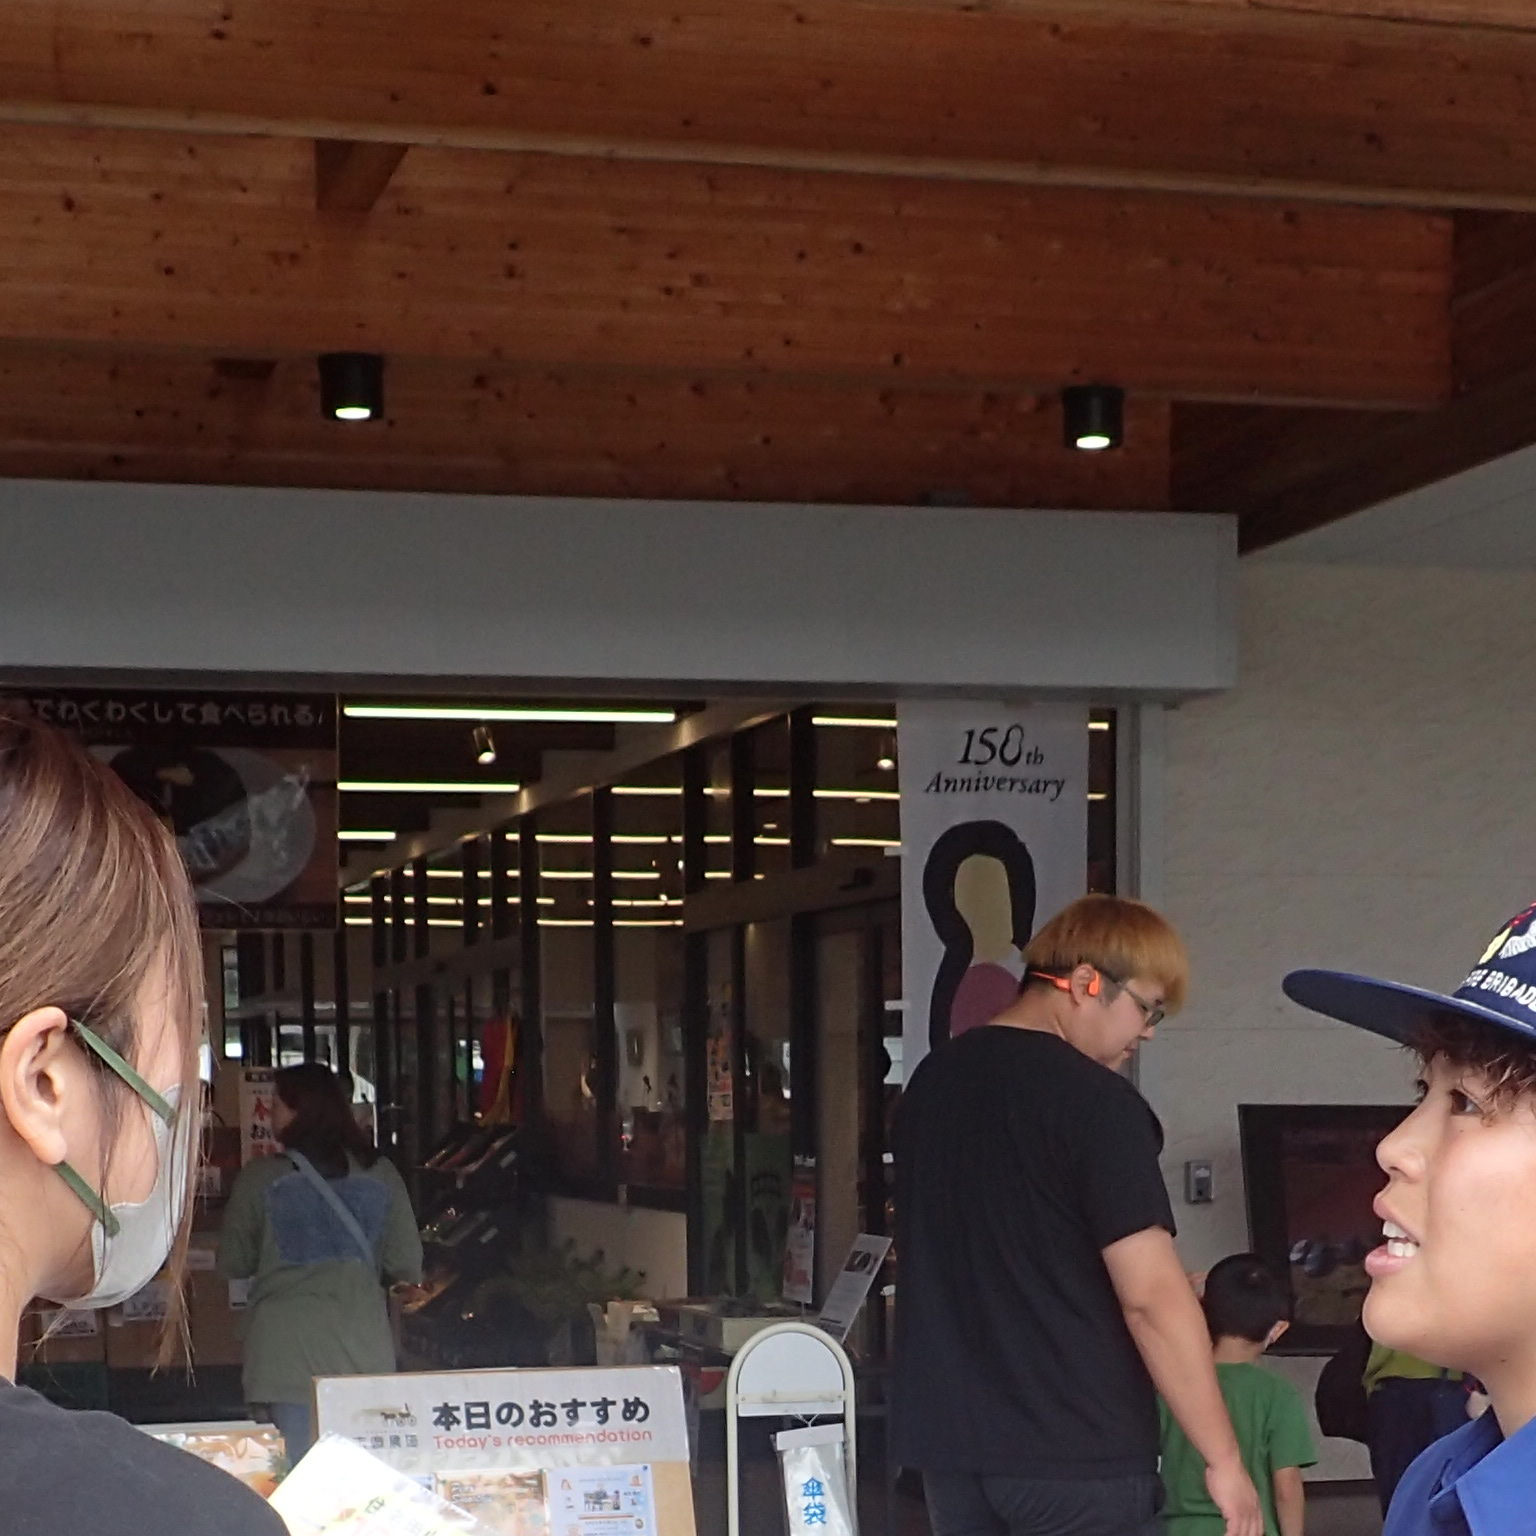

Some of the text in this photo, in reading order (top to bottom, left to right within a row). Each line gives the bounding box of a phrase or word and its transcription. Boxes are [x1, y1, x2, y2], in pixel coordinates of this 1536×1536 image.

[925, 770, 1065, 801] Anniversary
[432, 1396, 651, 1431] 本日のおすすめ
[434, 1428, 653, 1450] Today's recommendation
[801, 1477, 827, 1525] 傘袋
